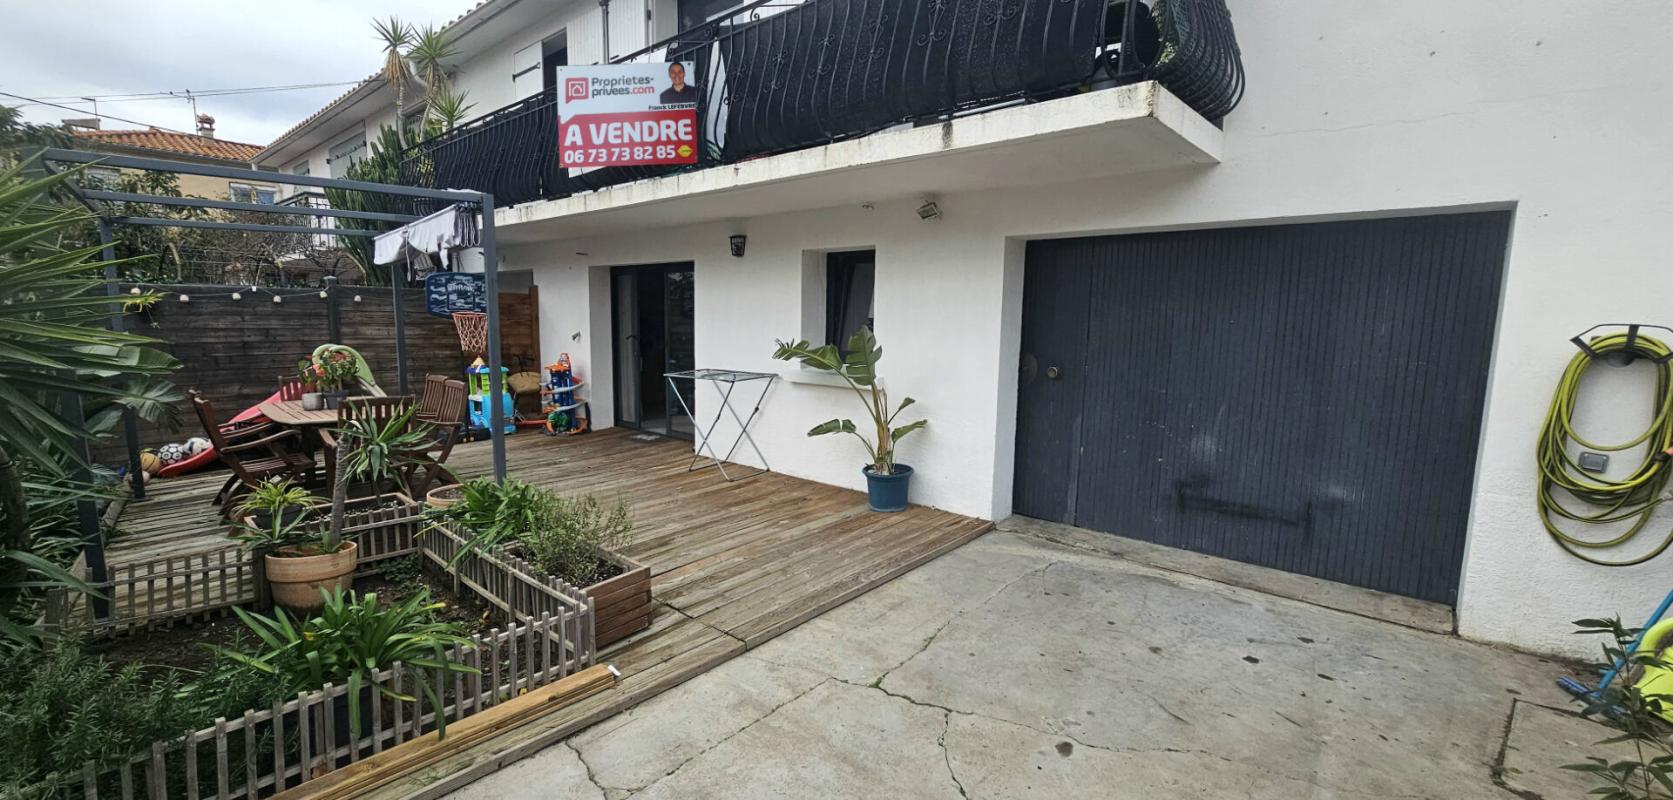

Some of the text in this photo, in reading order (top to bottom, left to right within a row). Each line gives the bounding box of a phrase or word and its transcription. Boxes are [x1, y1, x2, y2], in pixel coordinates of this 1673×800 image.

[591, 75, 654, 87] Proprietes-
[591, 85, 655, 98] privees.com
[564, 119, 693, 146] A VENDRE
[564, 145, 676, 163] 06 73 73 82 85
